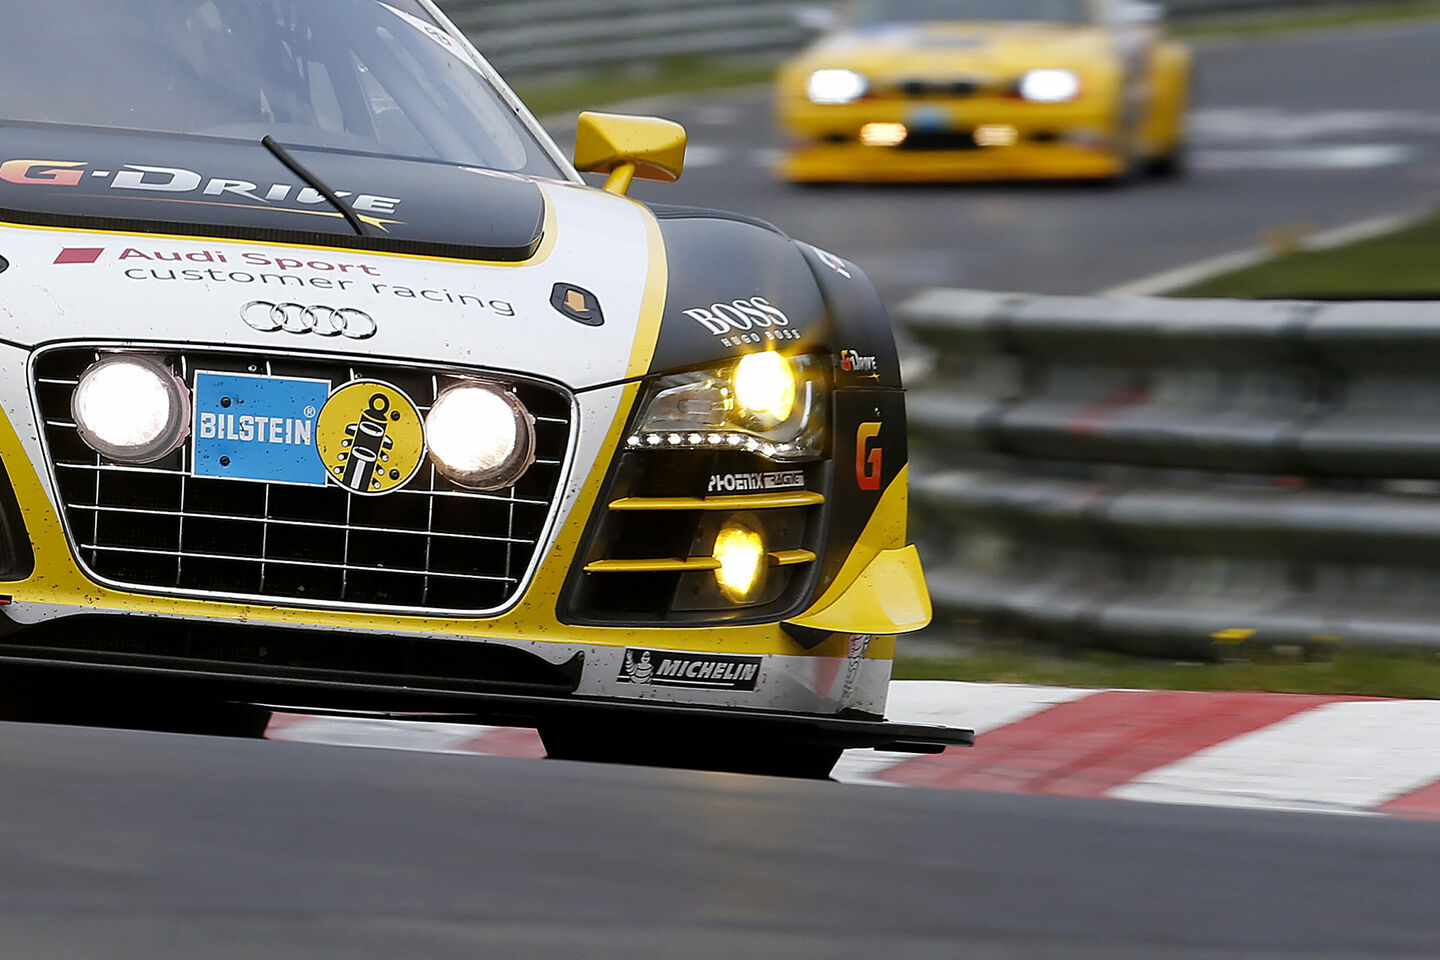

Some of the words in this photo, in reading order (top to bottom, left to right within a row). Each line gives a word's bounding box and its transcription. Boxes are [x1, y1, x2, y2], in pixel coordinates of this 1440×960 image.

[118, 247, 227, 264] Audi
[241, 251, 382, 277] Sport
[125, 264, 354, 291] customer
[372, 282, 516, 317] racing
[682, 296, 789, 336] BOSS
[721, 332, 761, 348] HUGO
[765, 329, 801, 341] BOSS
[200, 412, 311, 446] BILSTEIN
[855, 422, 883, 490] G
[656, 658, 759, 682] MICHELIN
